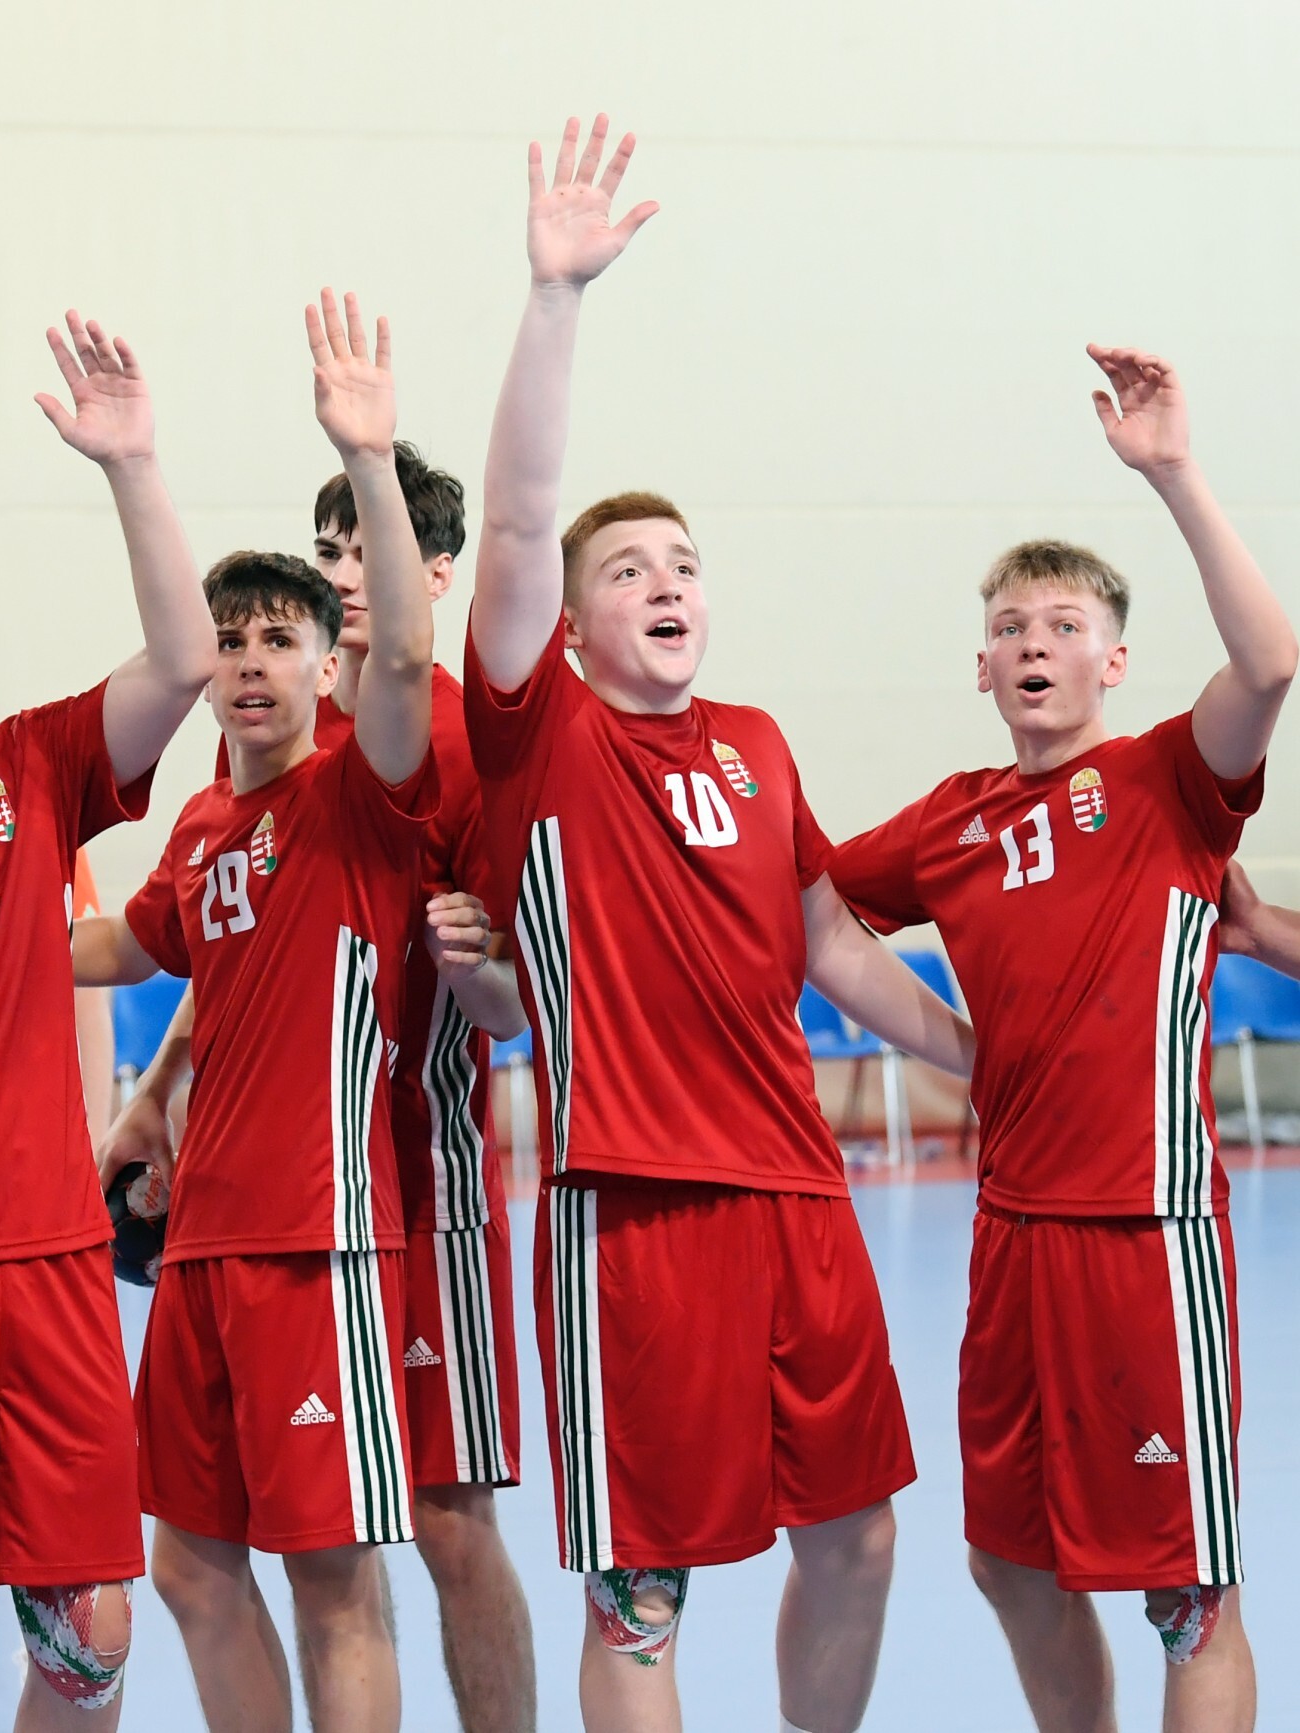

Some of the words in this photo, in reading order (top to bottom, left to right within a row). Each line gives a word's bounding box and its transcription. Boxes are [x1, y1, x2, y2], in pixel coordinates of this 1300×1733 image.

[664, 770, 739, 848] 10
[958, 832, 990, 845] adidas
[999, 802, 1055, 892] 13
[201, 850, 256, 942] 29
[290, 1411, 336, 1426] adidas
[1134, 1452, 1180, 1463] adidas
